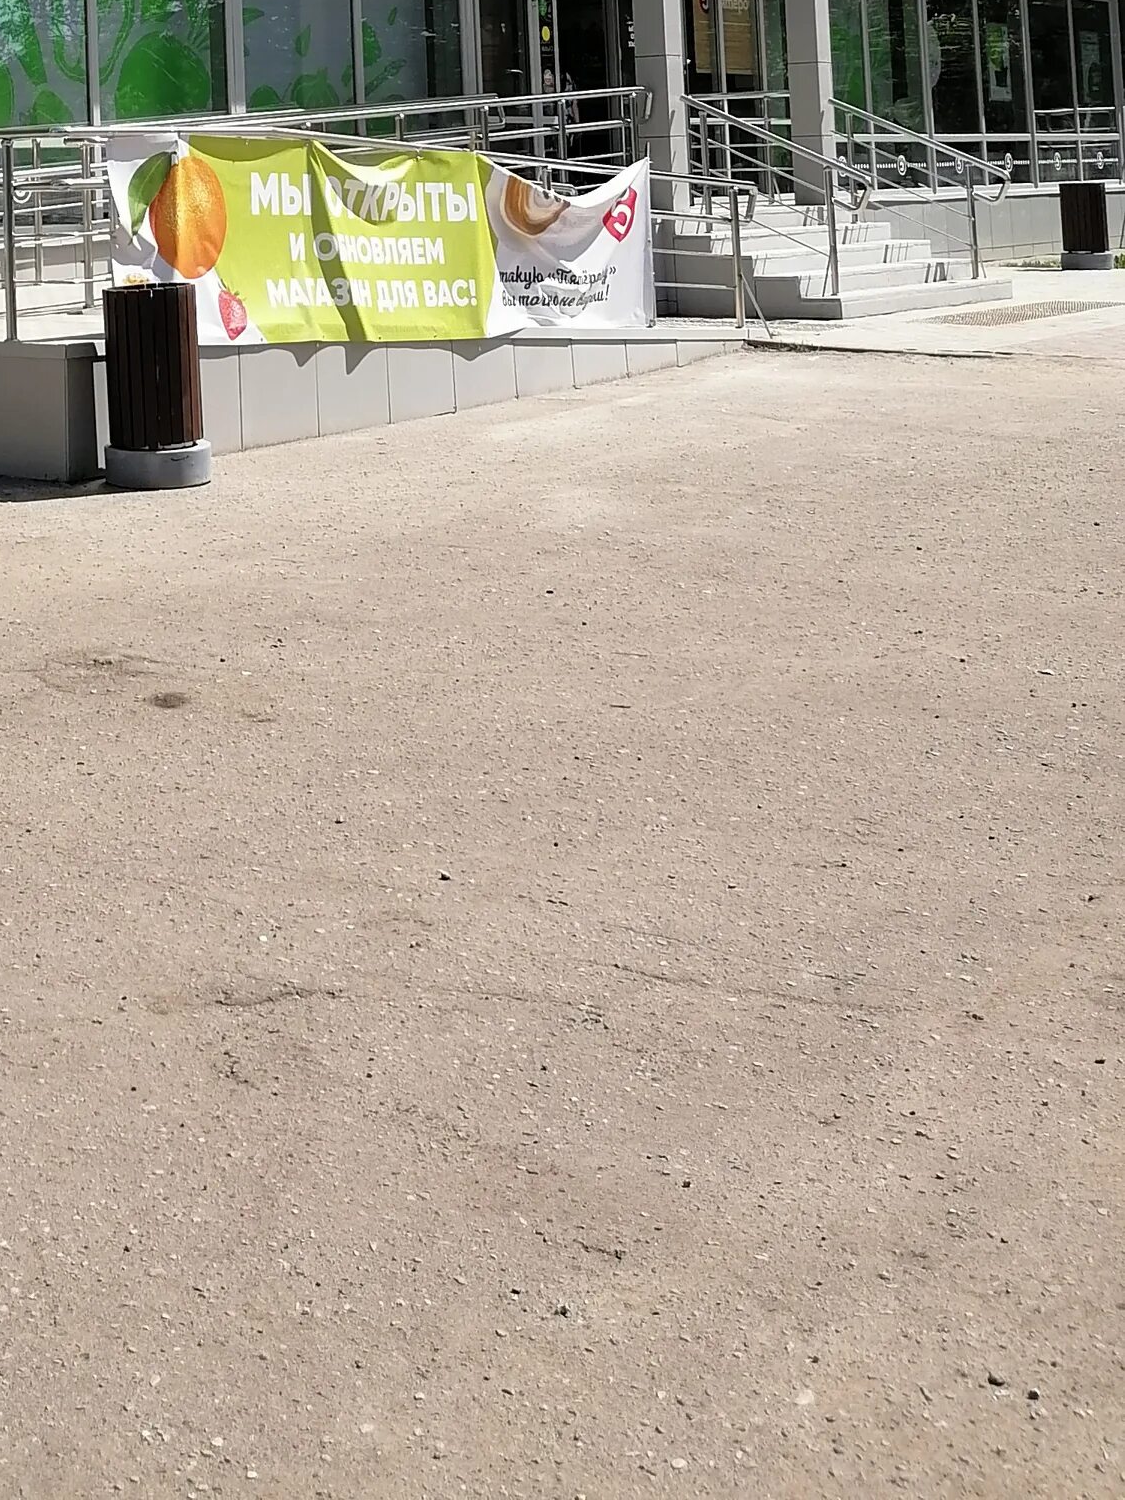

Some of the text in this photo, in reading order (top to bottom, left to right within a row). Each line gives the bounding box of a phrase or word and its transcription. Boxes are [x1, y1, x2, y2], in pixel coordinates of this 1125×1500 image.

[250, 172, 478, 222] МЫ ОТКРЫТЫ
[289, 233, 306, 262] И
[499, 265, 545, 290] такую
[266, 276, 478, 313] МАГАЗИН ДЛЯ ВАС!
